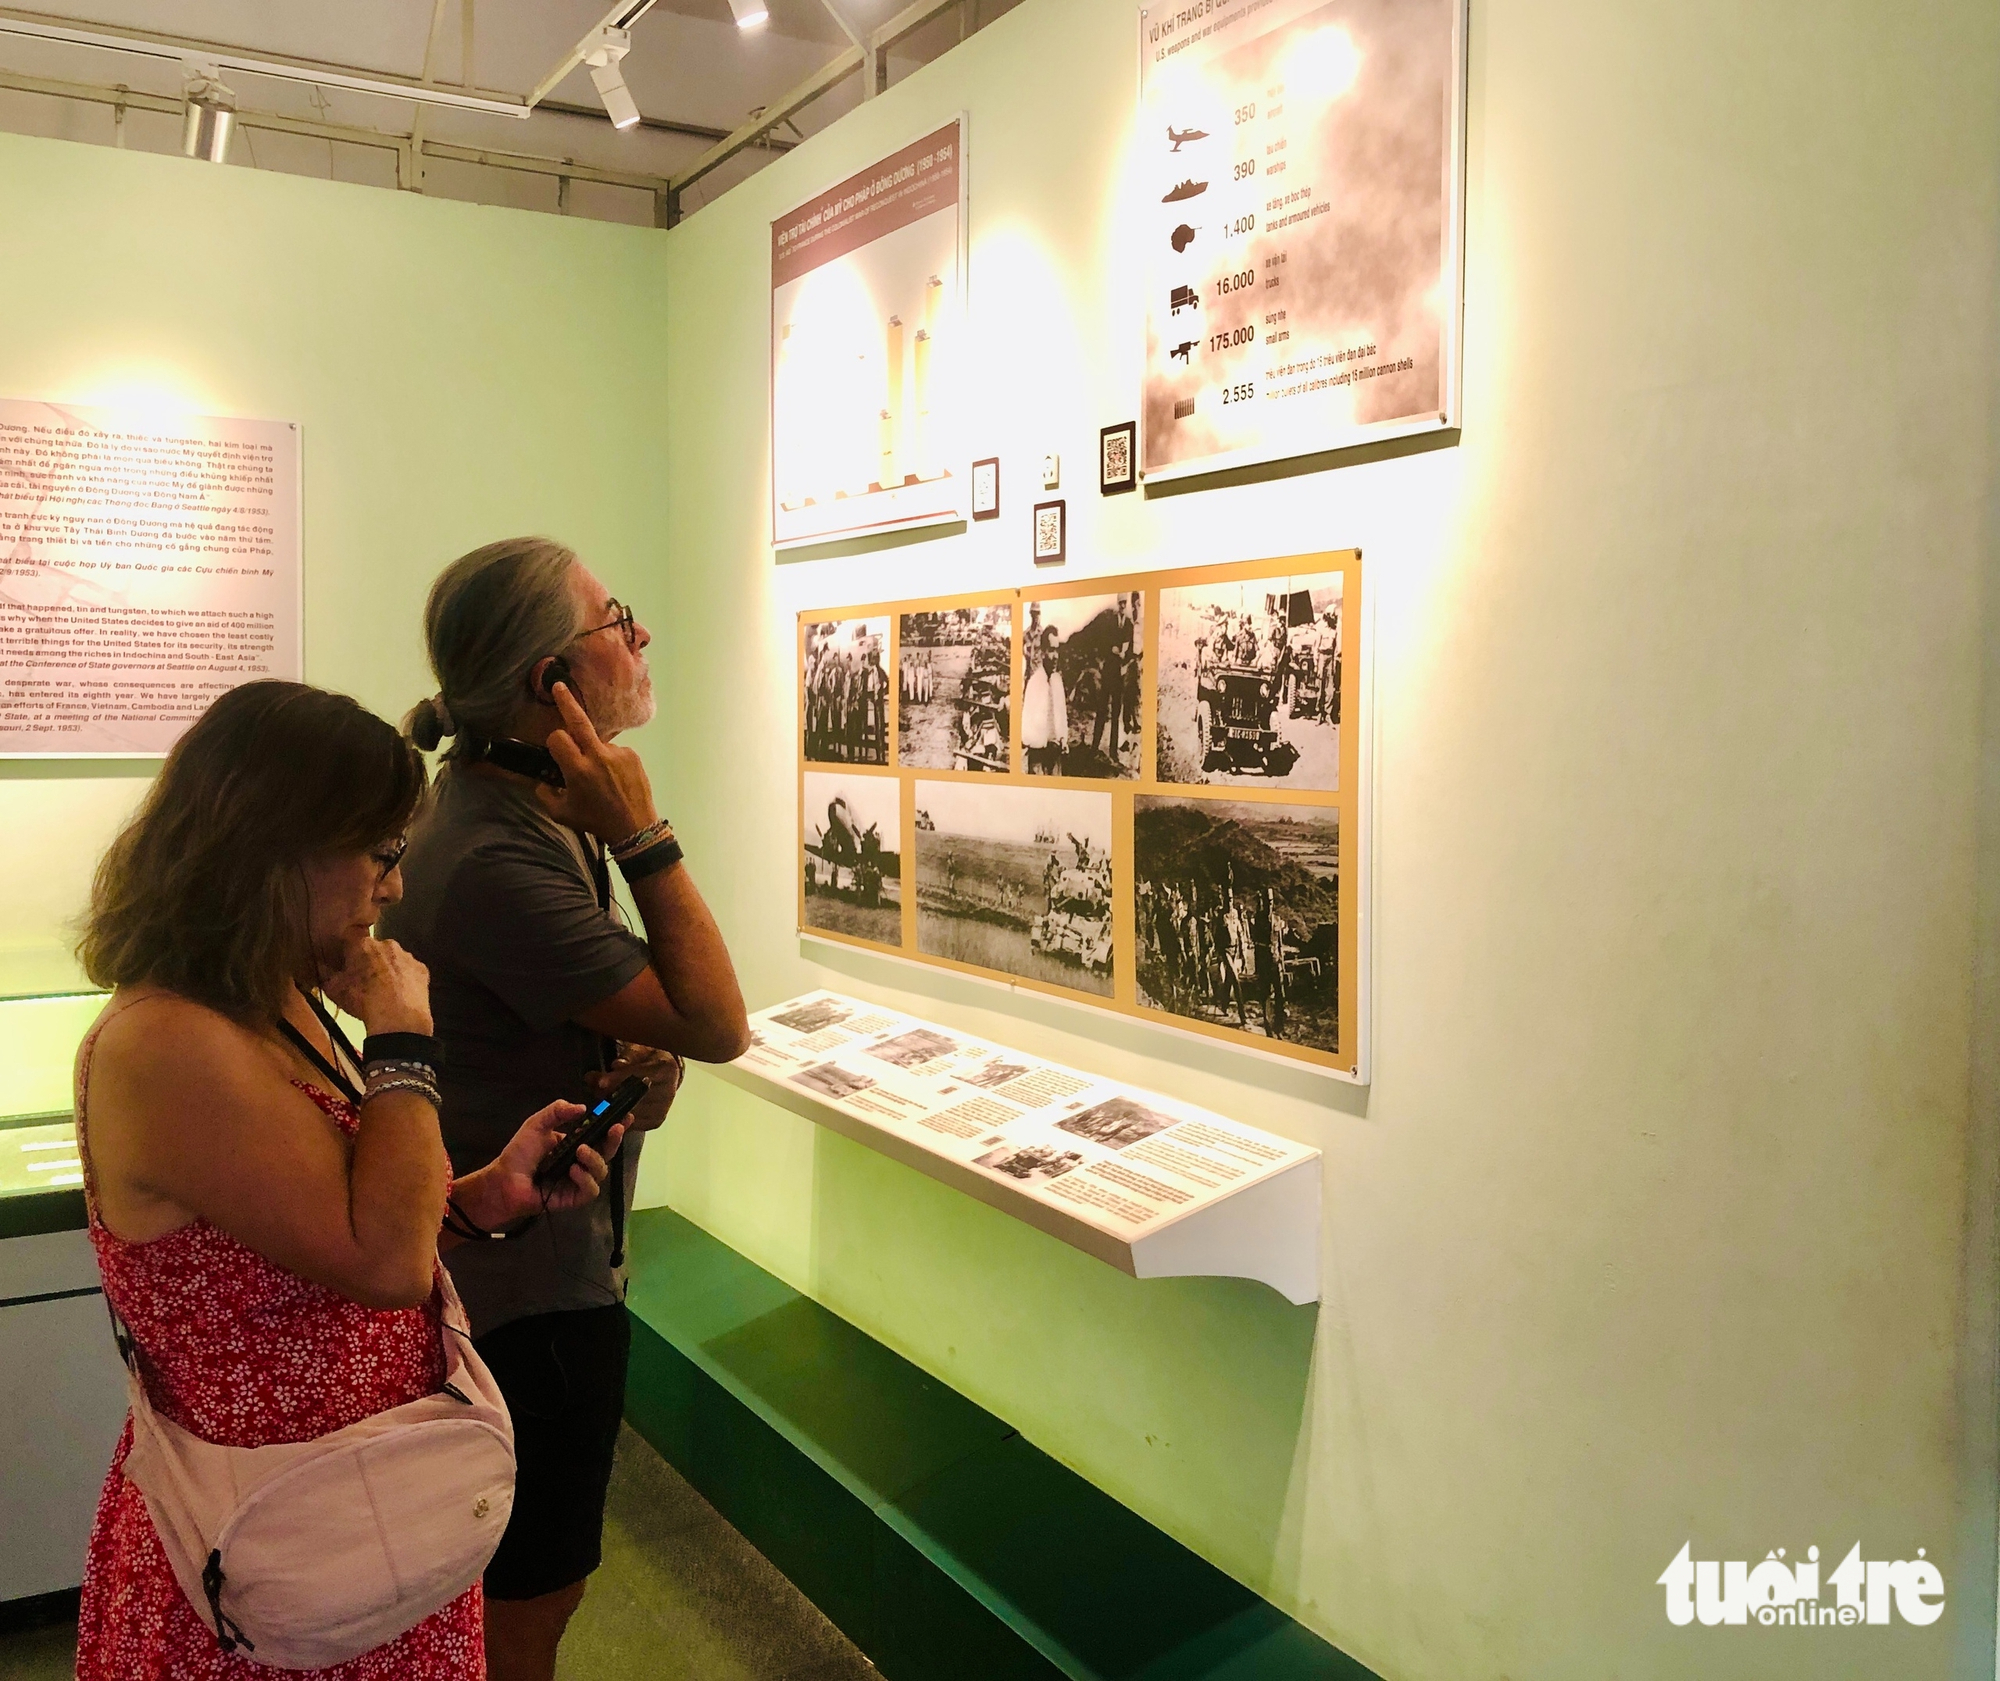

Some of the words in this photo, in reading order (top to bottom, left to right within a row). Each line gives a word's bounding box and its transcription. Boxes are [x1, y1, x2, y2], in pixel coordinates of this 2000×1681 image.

[1176, 2, 1203, 30] TRANG
[1191, 28, 1201, 44] and
[1235, 102, 1255, 125] 350
[1234, 158, 1255, 181] 390
[1288, 206, 1310, 225] armoured
[1311, 201, 1331, 217] vehicles
[1224, 214, 1255, 239] 1.400
[1217, 269, 1254, 296] 16.000
[1265, 276, 1280, 289] trucks
[1209, 325, 1255, 352] 175.000
[1358, 367, 1376, 380] million
[1376, 362, 1396, 376] cannon
[1397, 357, 1413, 371] shells
[1223, 382, 1254, 405] 2.555
[182, 503, 210, 512] Seattle
[203, 545, 230, 554] chung
[27, 604, 75, 613] happened,
[108, 607, 150, 615] tungsten,
[255, 612, 274, 620] high
[8, 615, 26, 623] why
[131, 619, 164, 627] decides
[249, 633, 274, 641] costly
[41, 638, 70, 647] things
[190, 642, 226, 650] security,
[239, 643, 274, 652] strength
[123, 651, 166, 659] Indochina
[216, 653, 234, 661] East
[25, 660, 77, 668] Conference
[208, 664, 238, 673] August
[5, 679, 50, 688] desperate
[82, 691, 111, 699] eighth
[181, 693, 210, 701] largely
[56, 702, 89, 710] France,
[54, 714, 89, 722] meeting
[32, 725, 55, 733] Sept.
